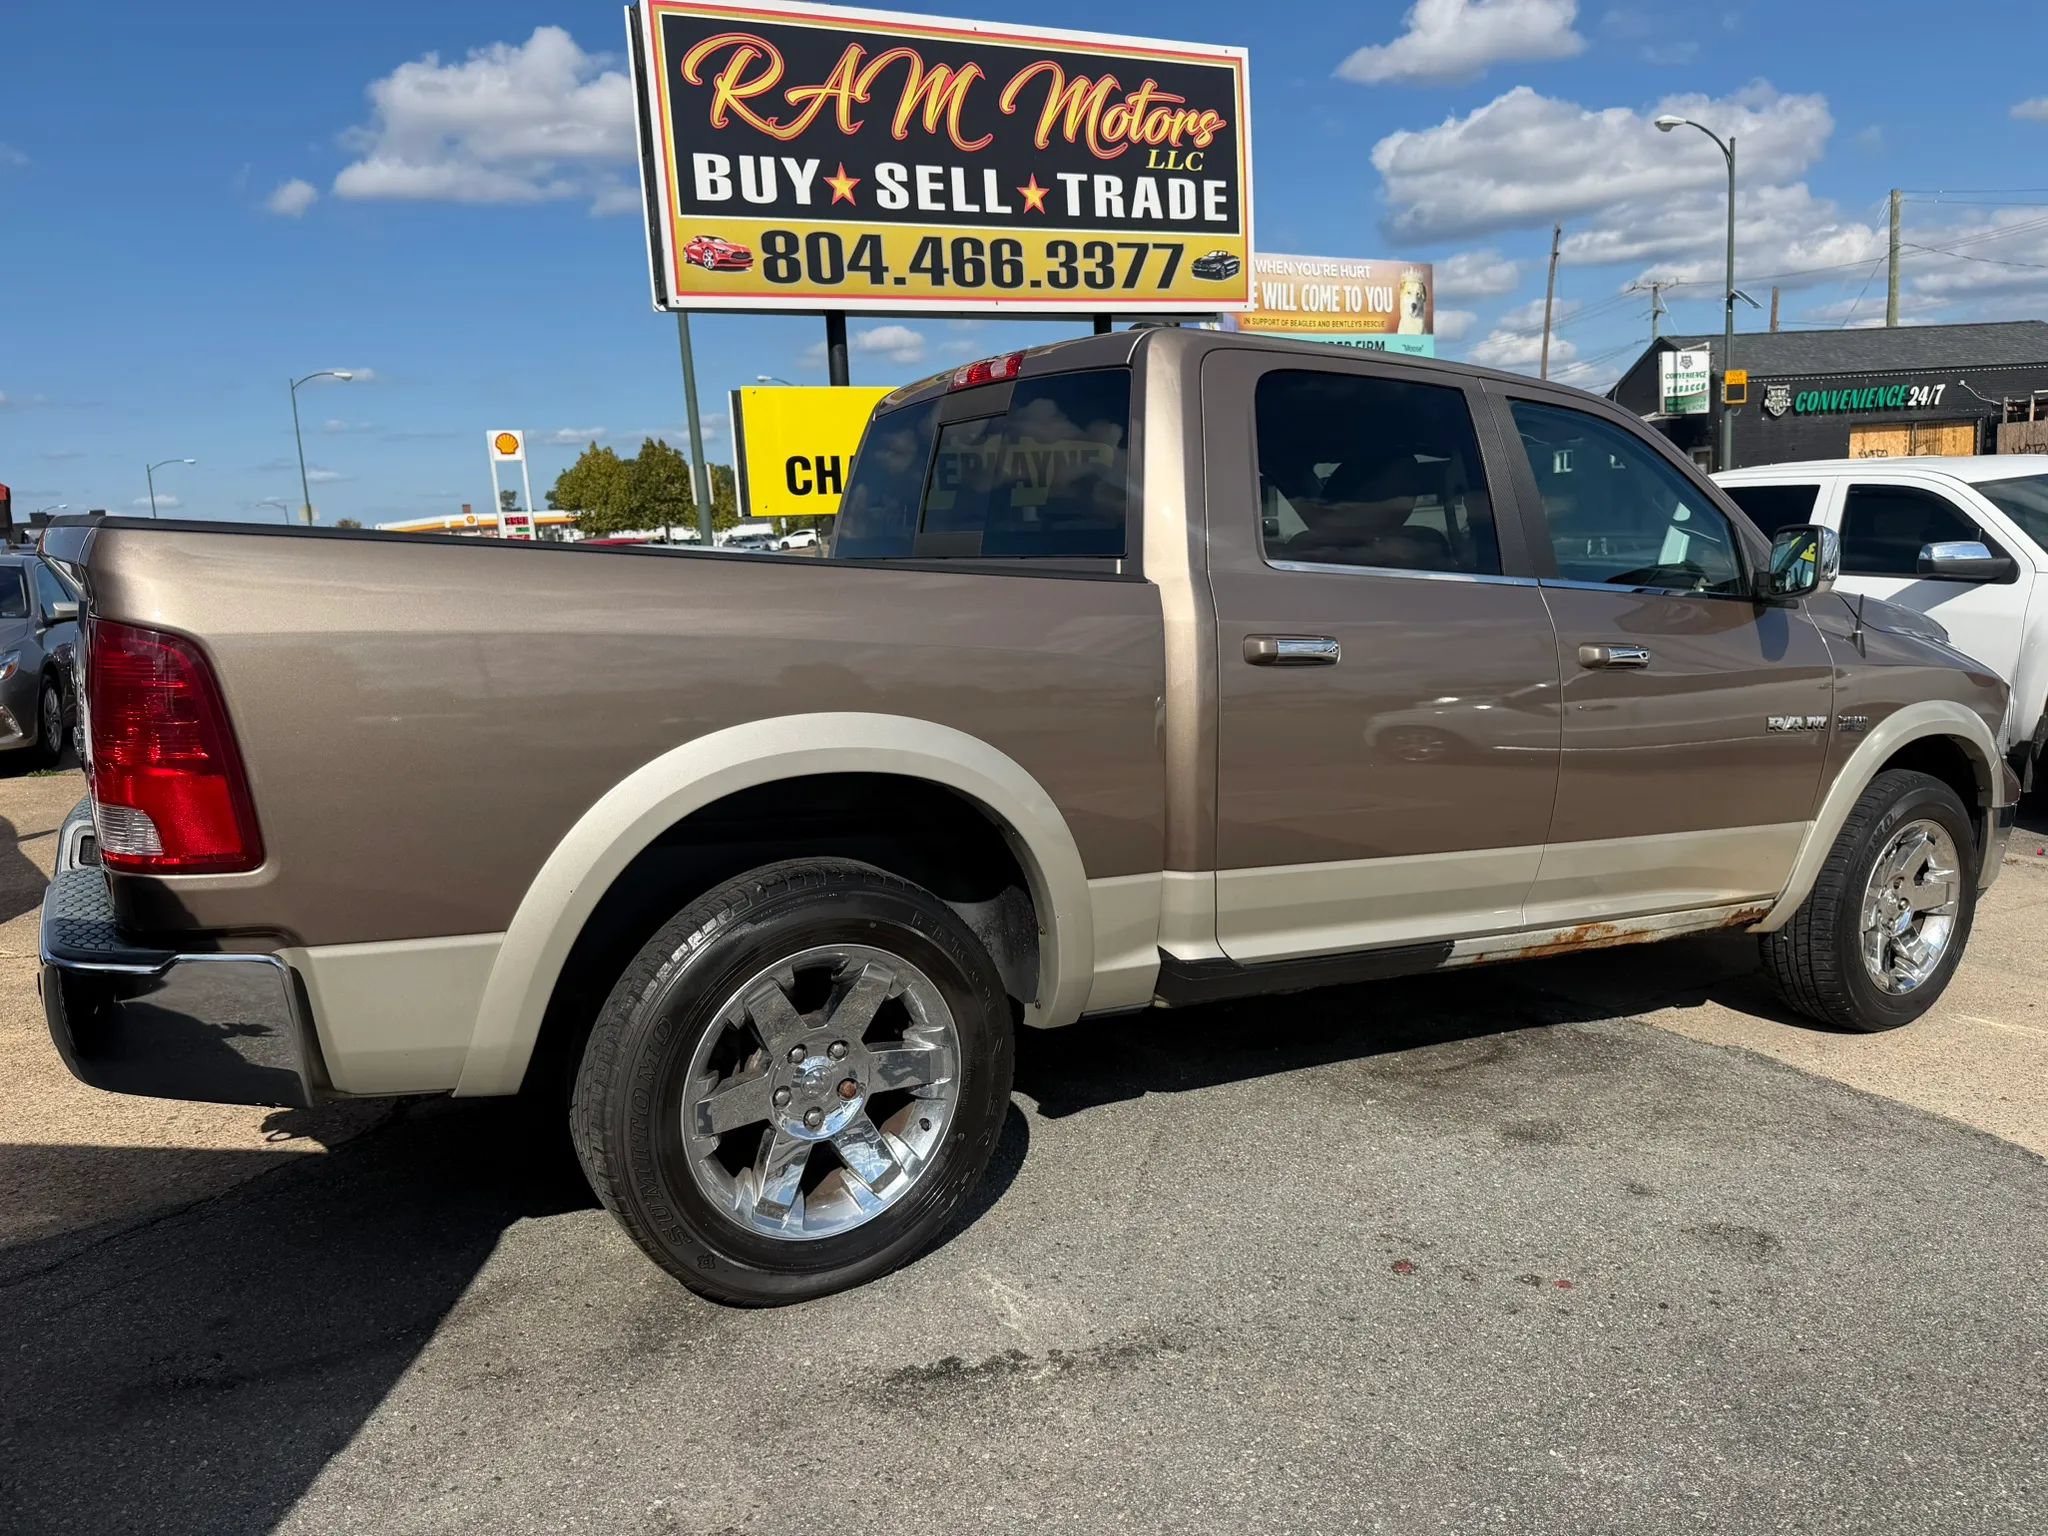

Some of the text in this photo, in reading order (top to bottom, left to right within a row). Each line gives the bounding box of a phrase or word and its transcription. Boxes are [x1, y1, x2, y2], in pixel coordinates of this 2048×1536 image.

[681, 33, 1227, 159] RAM Motors
[1146, 149, 1204, 173] LLC
[692, 152, 1228, 222] BUY SELL TRADE
[760, 229, 1186, 290] 804.466.3377
[1255, 261, 1371, 279] WHEN YOU'RE HURT
[1262, 282, 1297, 311] WILL
[1301, 284, 1341, 312] COME
[1343, 285, 1362, 312] TO
[1365, 286, 1394, 313] YOU
[1252, 318, 1279, 326] SUPPORT
[1318, 320, 1330, 328] AND
[1665, 371, 1707, 380] CONVENIENCE
[1666, 383, 1706, 393] TOBACCO
[1795, 384, 1945, 412] CONVENIENCE 24/7
[1767, 716, 1828, 731] RAM
[630, 1015, 694, 1246] SUMITOMO
